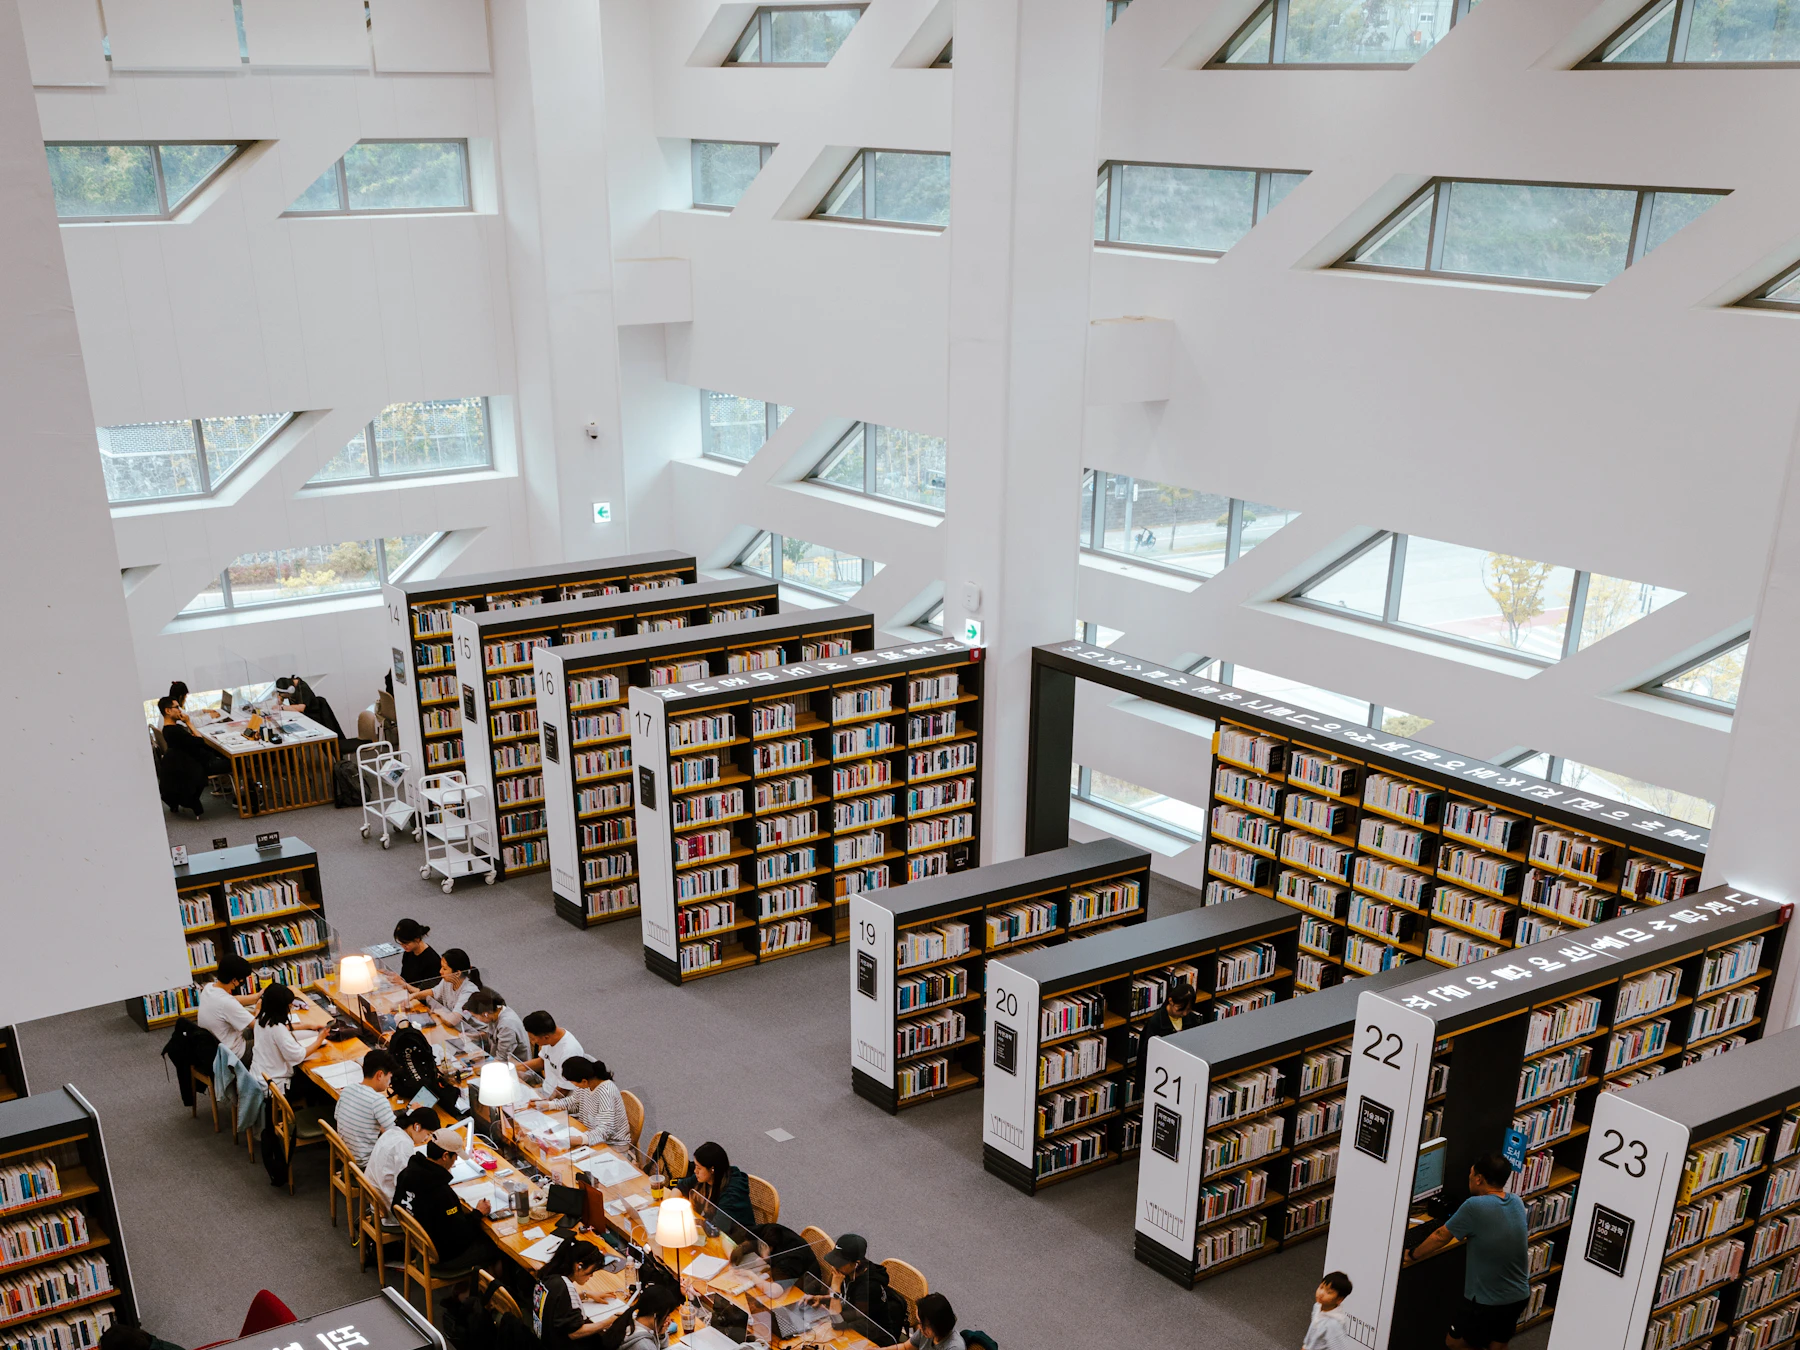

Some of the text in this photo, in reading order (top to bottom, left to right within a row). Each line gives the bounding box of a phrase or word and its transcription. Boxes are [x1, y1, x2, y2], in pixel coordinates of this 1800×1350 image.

[388, 602, 400, 626] 14
[457, 635, 471, 660] 15
[539, 669, 554, 696] 16
[635, 711, 652, 738] 17
[859, 920, 876, 946] 19
[995, 987, 1018, 1017] 20
[1362, 1024, 1404, 1071] 22
[1153, 1066, 1182, 1105] 21
[1364, 1109, 1386, 1125] 기술과학
[1507, 1146, 1521, 1159] 도서
[1597, 1129, 1649, 1179] 23
[1596, 1226, 1609, 1236] 500
[1597, 1218, 1624, 1237] 기술과학
